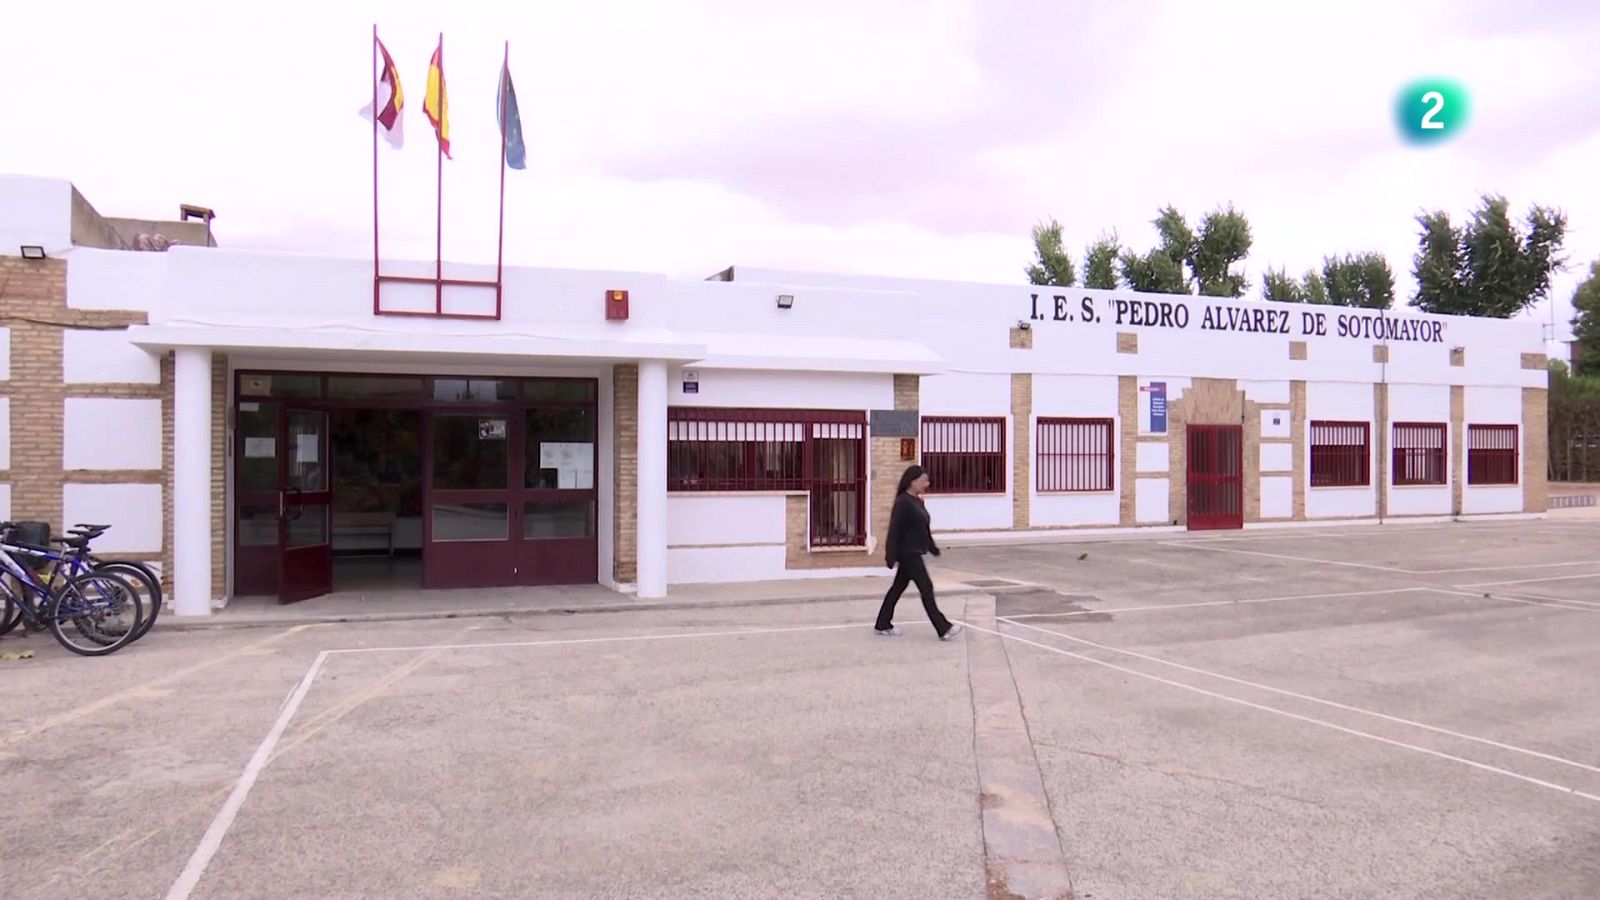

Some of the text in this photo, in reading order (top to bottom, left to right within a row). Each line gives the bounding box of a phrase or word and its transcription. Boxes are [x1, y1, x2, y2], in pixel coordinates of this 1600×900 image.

[1030, 294, 1447, 342] I. E. S. "PEDRO ALVAREZ DE SOTOMAYOR"
